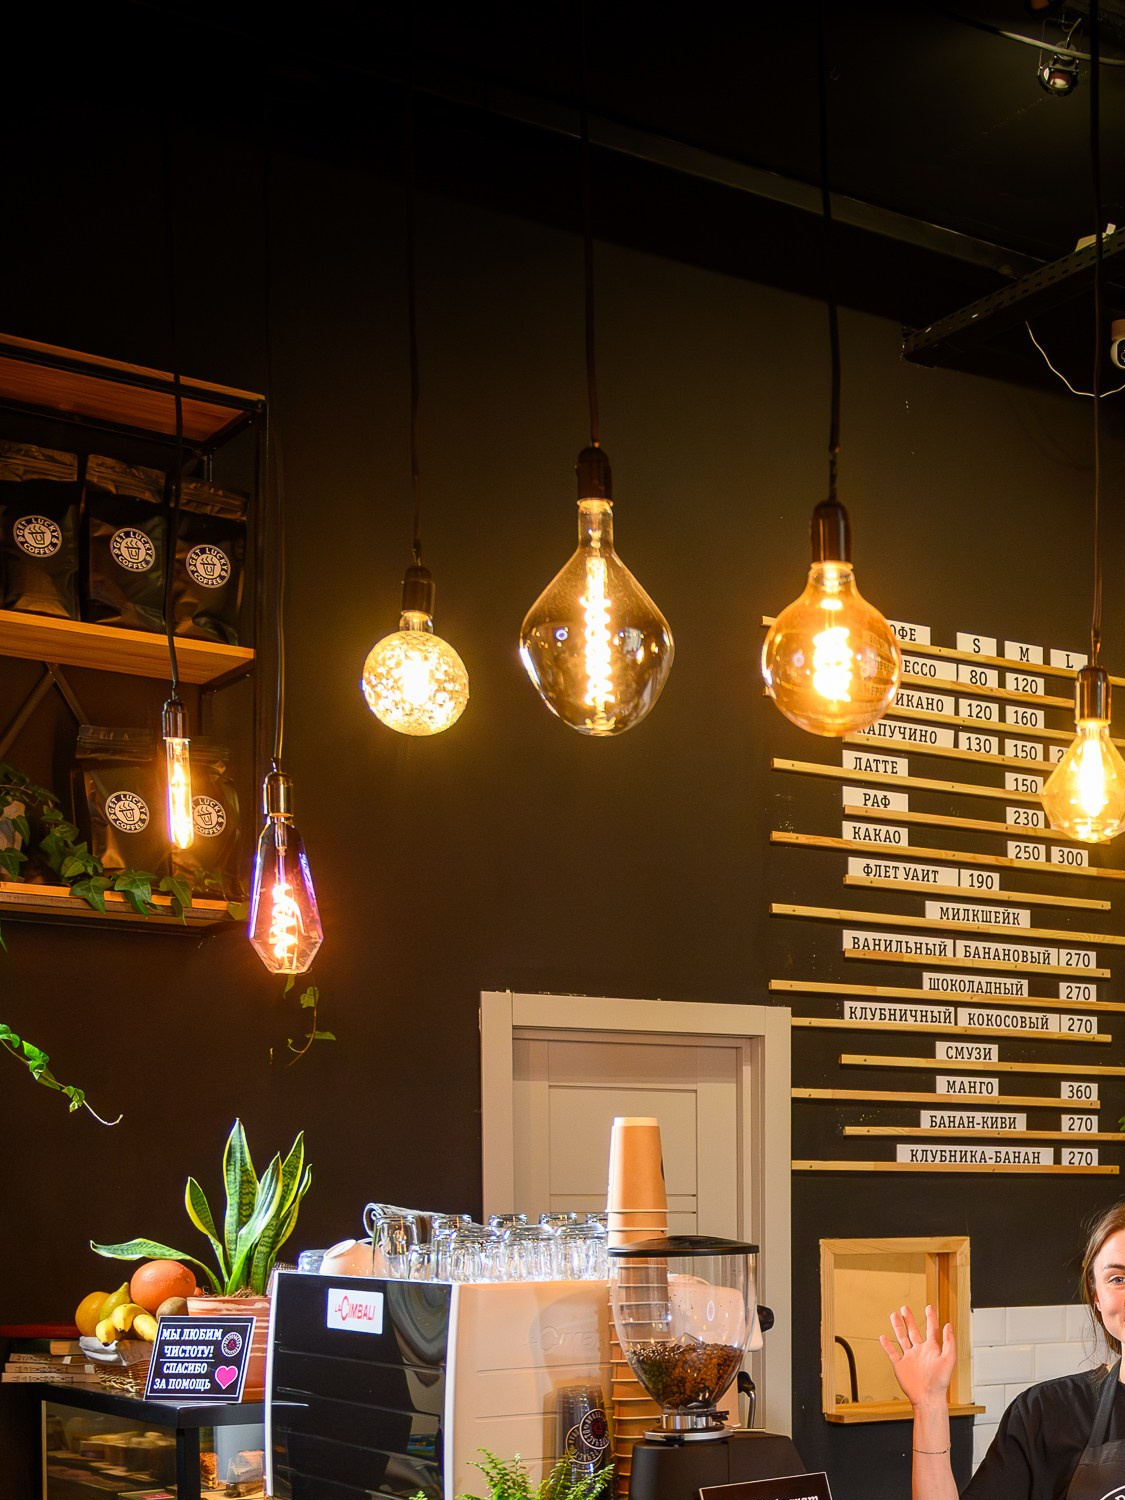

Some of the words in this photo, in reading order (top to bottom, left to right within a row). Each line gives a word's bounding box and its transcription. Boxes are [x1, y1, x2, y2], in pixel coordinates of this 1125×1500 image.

[17, 521, 28, 536] GET
[32, 518, 59, 537] LUCKY
[24, 544, 54, 555] COFFEE
[973, 638, 980, 653] S
[1020, 646, 1030, 662] M
[1066, 654, 1073, 669] L
[853, 756, 898, 775] ЛАТТЕ
[1013, 777, 1038, 794] 150
[863, 793, 891, 809] РАФ
[1013, 811, 1039, 827] 230
[852, 826, 901, 844] КАКАО
[1015, 845, 1040, 861] 250
[1058, 850, 1083, 866] 300
[863, 864, 899, 881] ФЛЕТ
[902, 867, 938, 884] УАИТ
[969, 873, 994, 889] 190
[939, 905, 1020, 926] МИЛКШЕЙК
[852, 935, 947, 957] ВАНИЛЬНЫЙ
[964, 944, 1051, 966] БАНАНОВЫЙ
[1066, 952, 1090, 968] 270
[928, 977, 1024, 997] ШОКОЛАДНЫЙ
[1066, 985, 1090, 1001] 270
[849, 1005, 952, 1024] КЛУБНИЧНЫЙ
[967, 1011, 1049, 1031] КОКОСОВЫЙ
[1068, 1018, 1092, 1034] 270
[946, 1045, 992, 1061] СМУЗИ
[946, 1079, 994, 1095] МАНГО
[1068, 1084, 1092, 1100] 360
[929, 1113, 1017, 1131] БАНАН-КИВИ
[1068, 1117, 1092, 1132] 270
[910, 1148, 1041, 1165] КЛУБНИКА-БАНАН
[1068, 1151, 1092, 1166] 270
[340, 1295, 376, 1321] CIMBALI
[161, 1329, 180, 1340] МЫ
[181, 1329, 222, 1340] ЛЮБИМ
[164, 1346, 214, 1357] ЧИСТОТУ!
[164, 1363, 207, 1374] СПАСИБО
[154, 1379, 167, 1389] ЗА
[169, 1379, 211, 1391] ПОМОЩЬ
